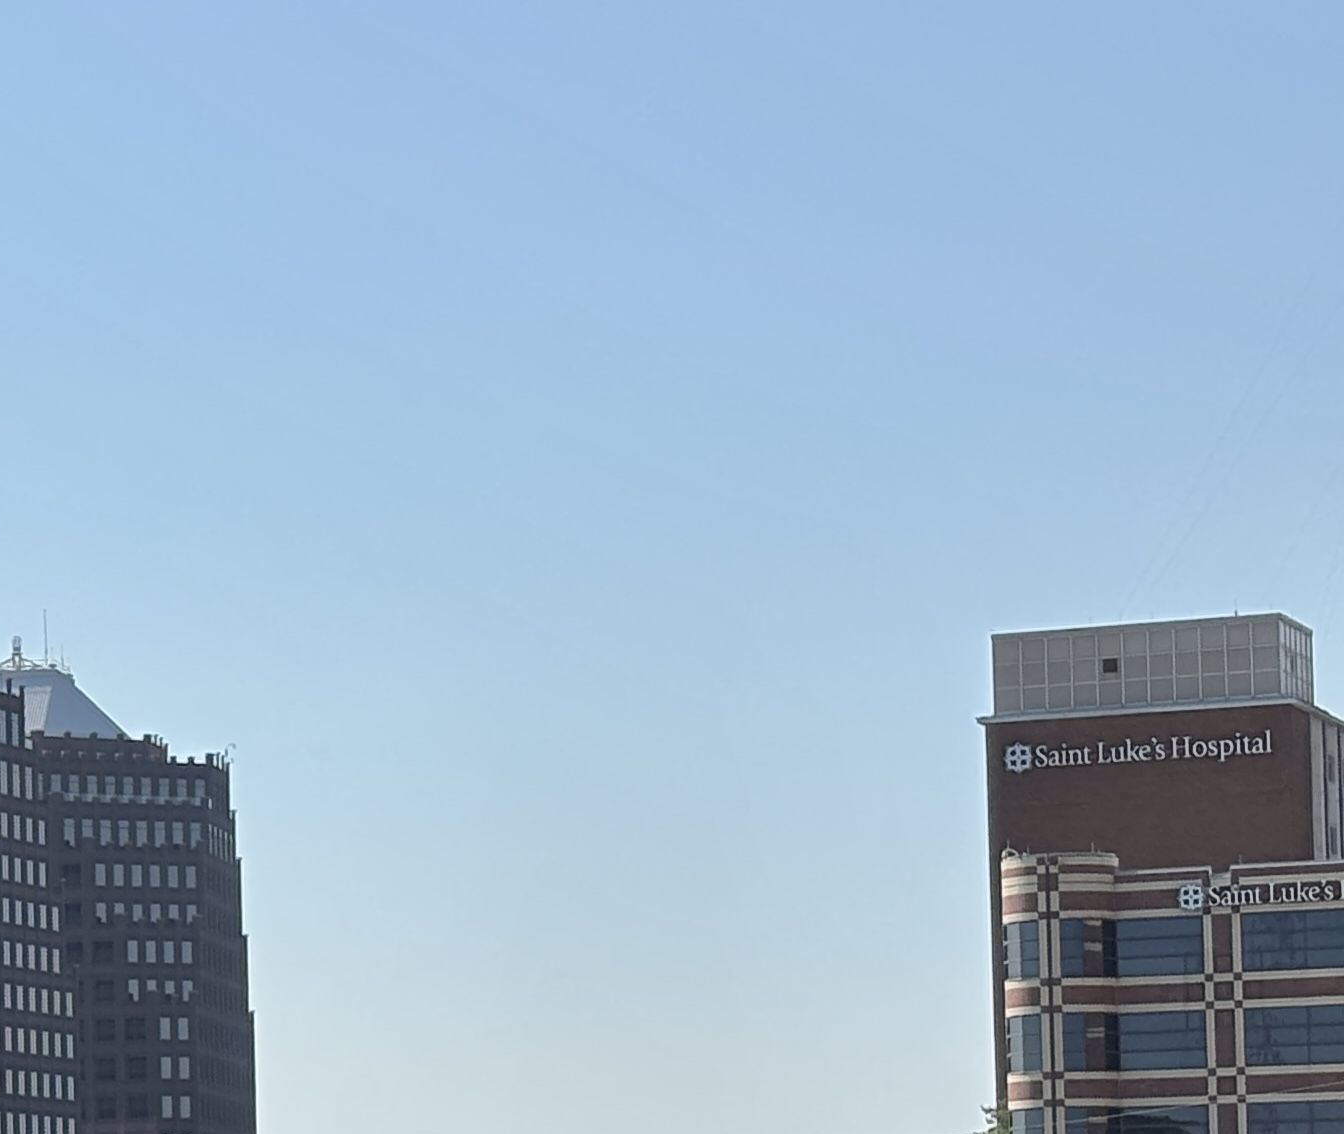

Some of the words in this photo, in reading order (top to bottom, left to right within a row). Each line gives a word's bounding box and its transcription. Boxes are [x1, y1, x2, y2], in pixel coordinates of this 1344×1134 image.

[1034, 744, 1092, 768] Saint
[1098, 739, 1166, 763] Luke's
[1171, 729, 1272, 762] Hospital
[1208, 884, 1261, 906] Saint
[1269, 880, 1334, 902] Luke's
